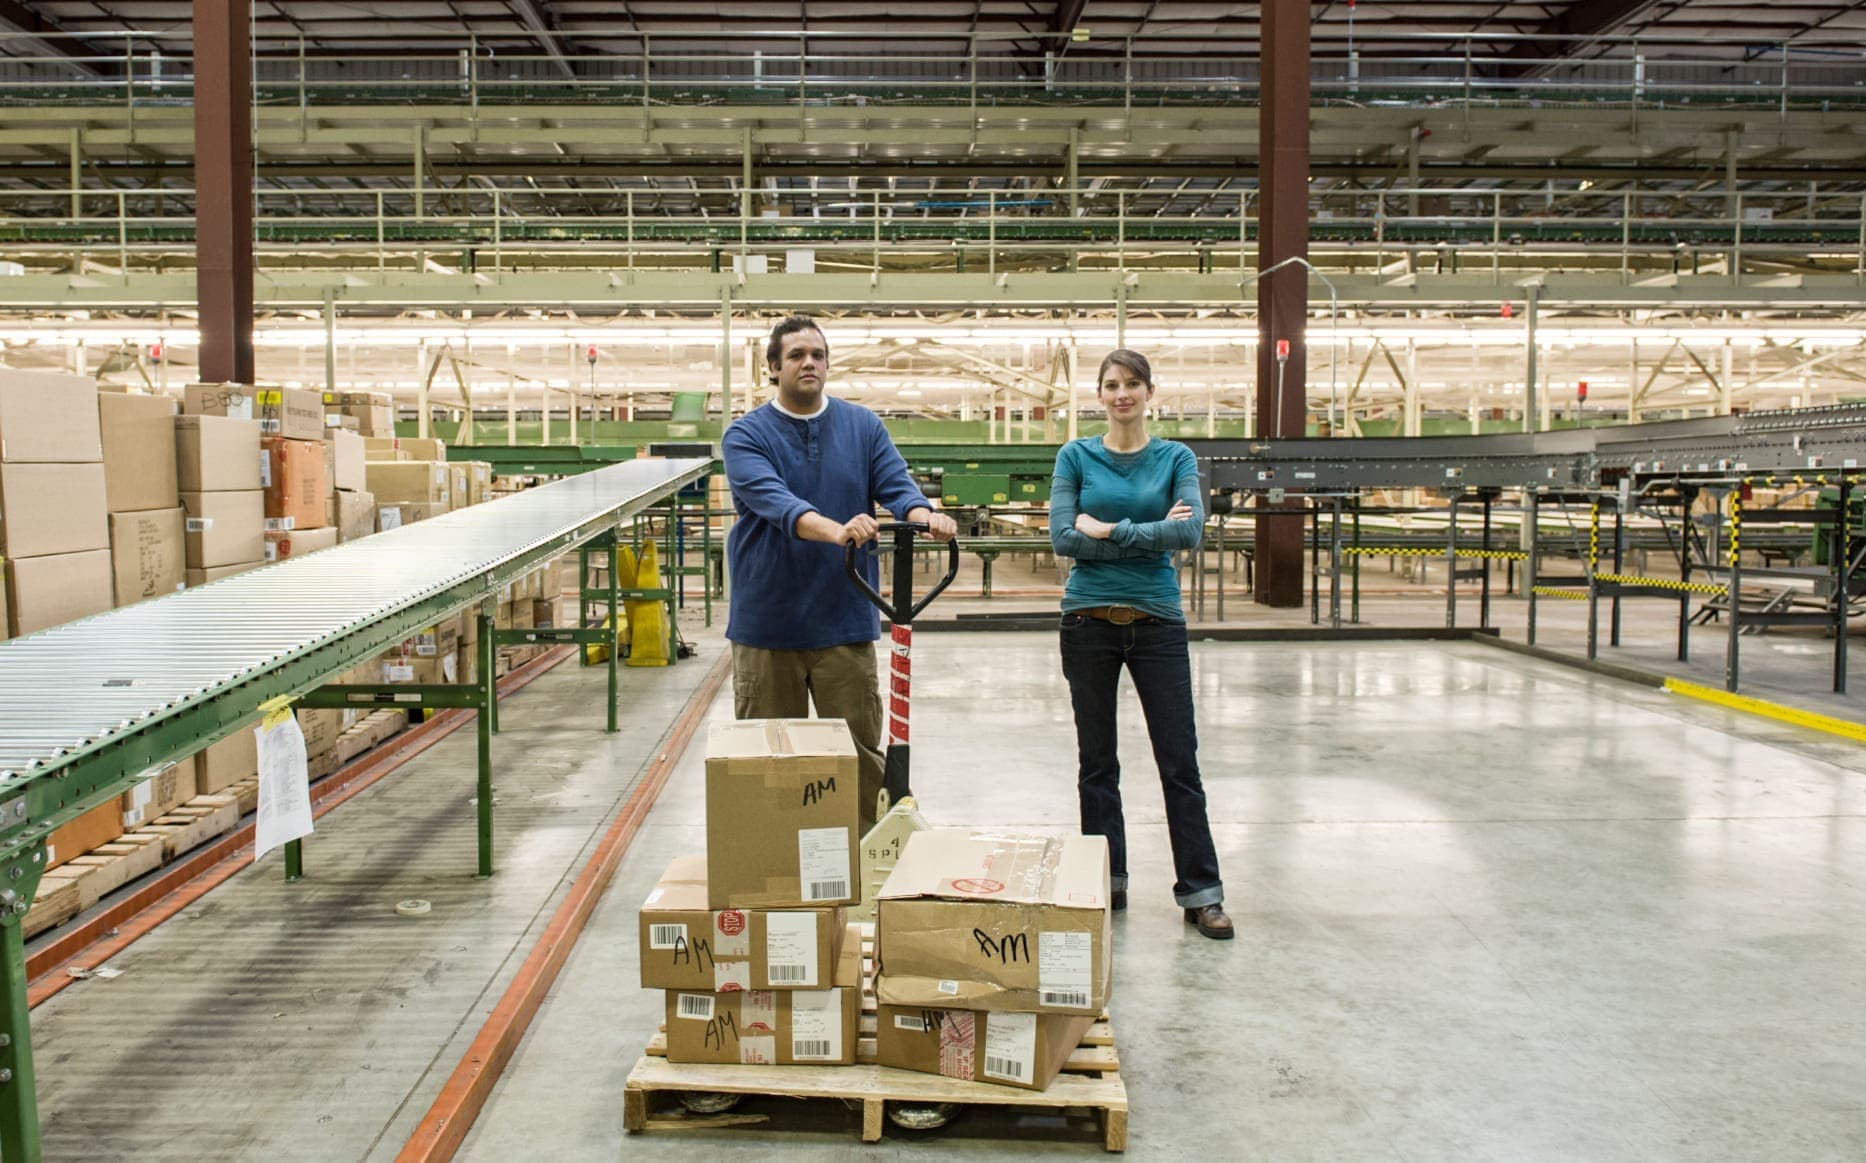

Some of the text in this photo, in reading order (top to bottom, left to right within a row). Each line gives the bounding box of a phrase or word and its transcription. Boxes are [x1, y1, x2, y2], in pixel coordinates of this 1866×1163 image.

[803, 776, 836, 806] AM
[891, 836, 899, 848] 4
[723, 912, 740, 932] STOP
[673, 935, 715, 973] AM
[972, 928, 1030, 964] AM
[704, 1010, 739, 1051] AM
